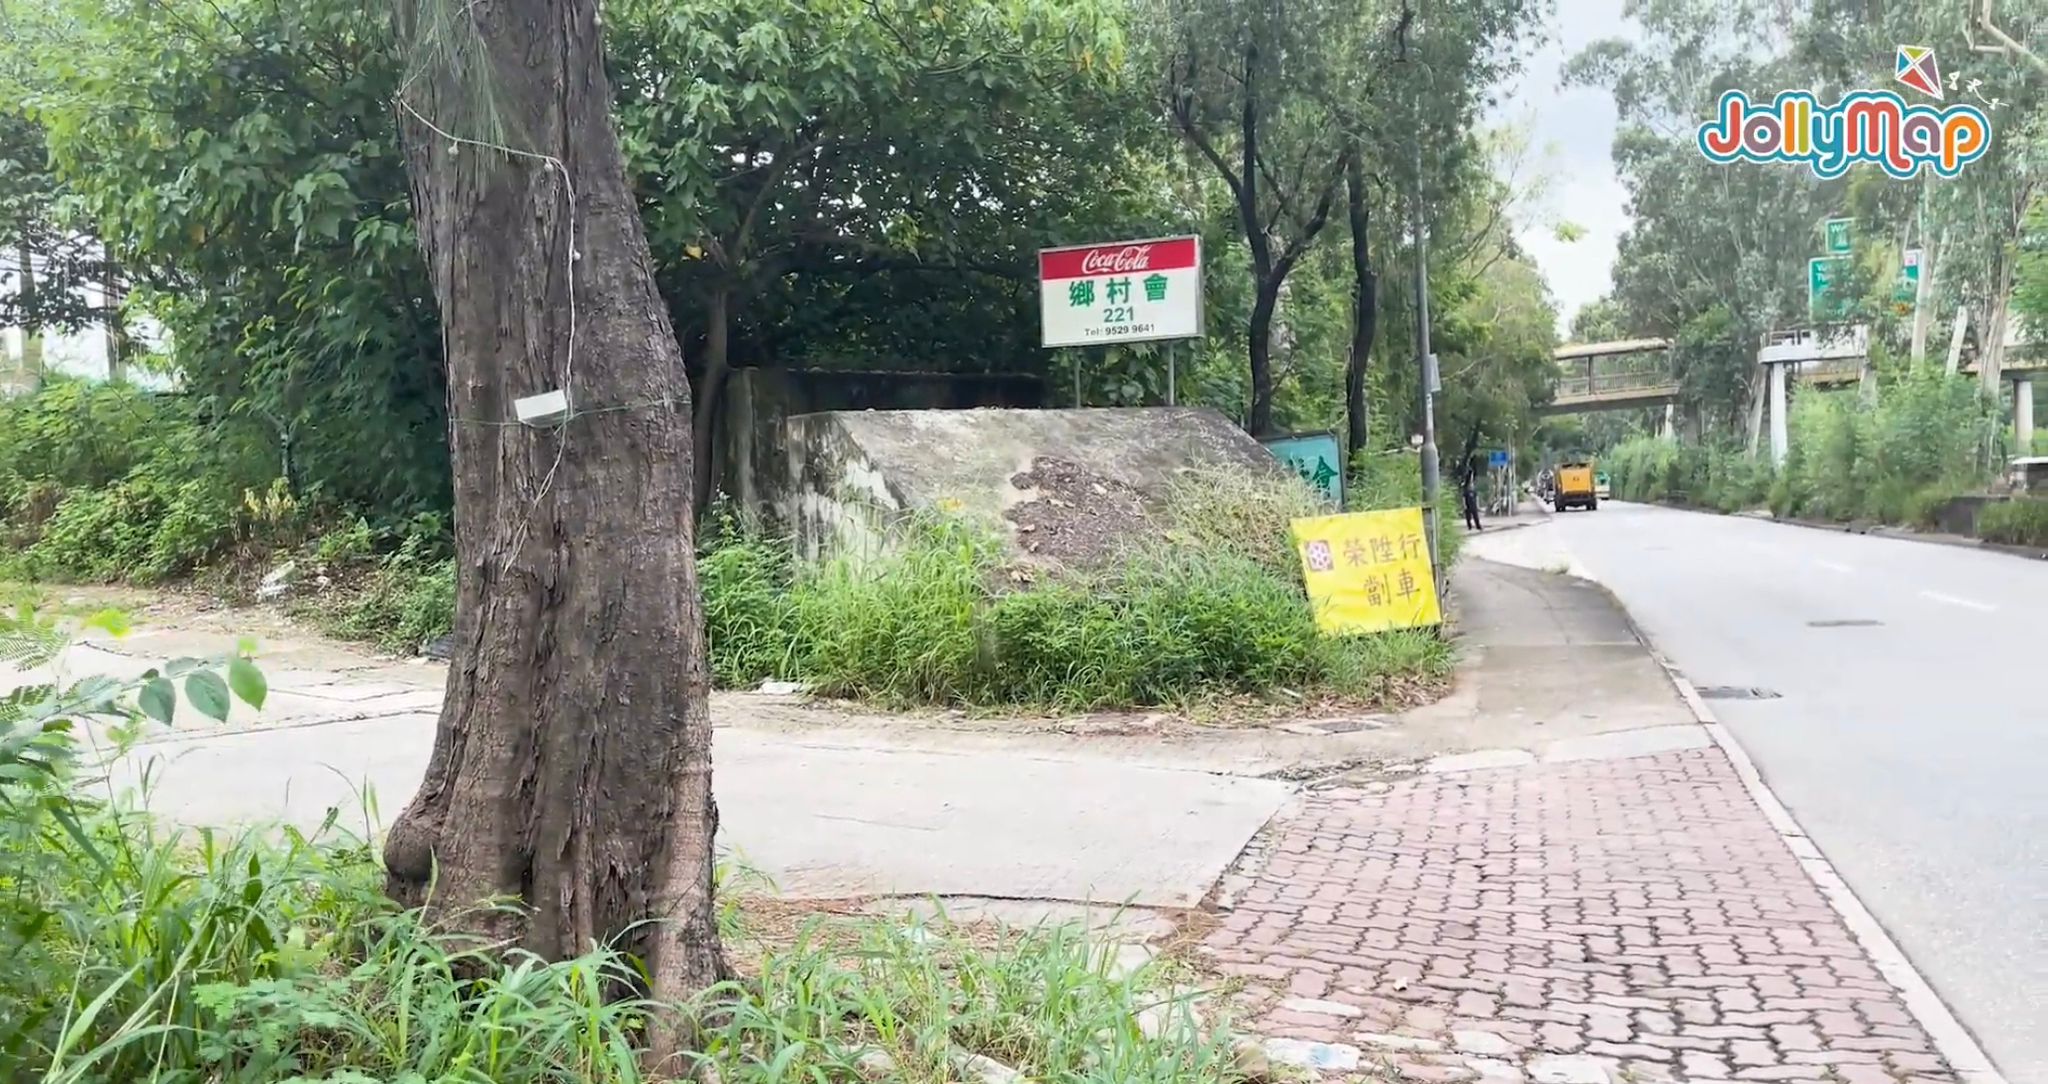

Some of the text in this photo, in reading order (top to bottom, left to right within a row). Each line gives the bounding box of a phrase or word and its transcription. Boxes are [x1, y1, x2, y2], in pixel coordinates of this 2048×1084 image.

[1081, 246, 1152, 274] Coca-Cola
[1069, 273, 1168, 307] 鄉村會
[1103, 306, 1134, 323] 221
[1105, 324, 1129, 336] 9529
[1131, 323, 1155, 334] 9641
